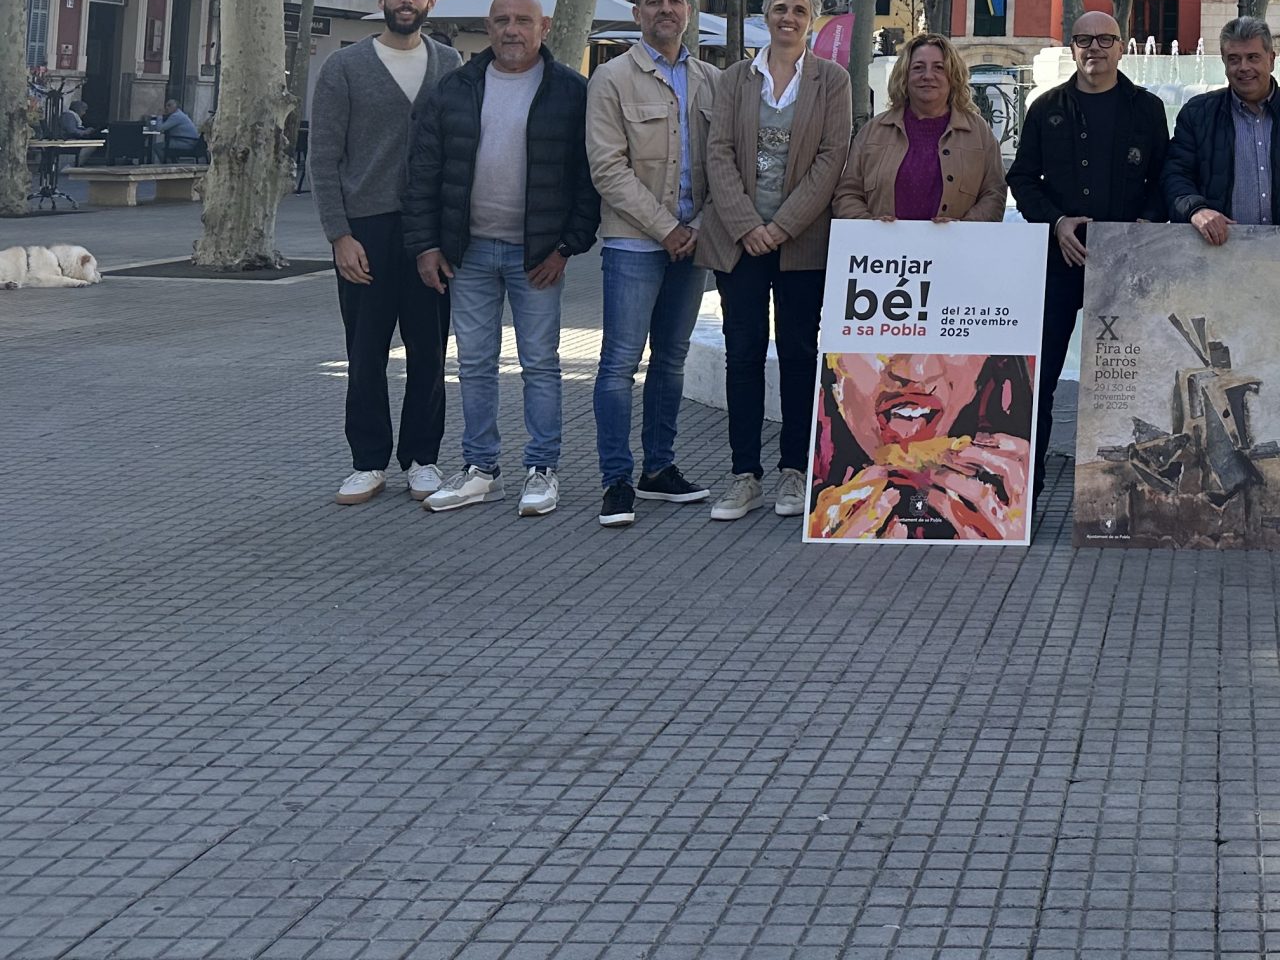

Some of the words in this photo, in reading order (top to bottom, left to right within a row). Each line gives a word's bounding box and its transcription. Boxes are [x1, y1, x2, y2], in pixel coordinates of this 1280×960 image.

[849, 255, 932, 277] Menjar
[844, 277, 931, 321] bé!
[941, 306, 960, 316] del
[964, 307, 976, 316] 21
[980, 307, 990, 316] al
[995, 307, 1009, 316] 30
[941, 317, 955, 326] de
[959, 317, 1018, 327] novembre
[1096, 315, 1119, 341] X
[842, 325, 851, 336] a
[857, 325, 874, 336] sa
[880, 323, 926, 337] Pobla
[940, 327, 970, 337] 2025
[1096, 342, 1121, 354] Fira
[1124, 343, 1141, 355] de
[1095, 355, 1137, 367] l'arròs
[1095, 368, 1138, 382] pobler
[1094, 383, 1105, 391] 29
[1112, 384, 1124, 392] 30
[1125, 384, 1136, 392] de
[1094, 393, 1136, 401] novembre
[1106, 401, 1128, 410] 2025
